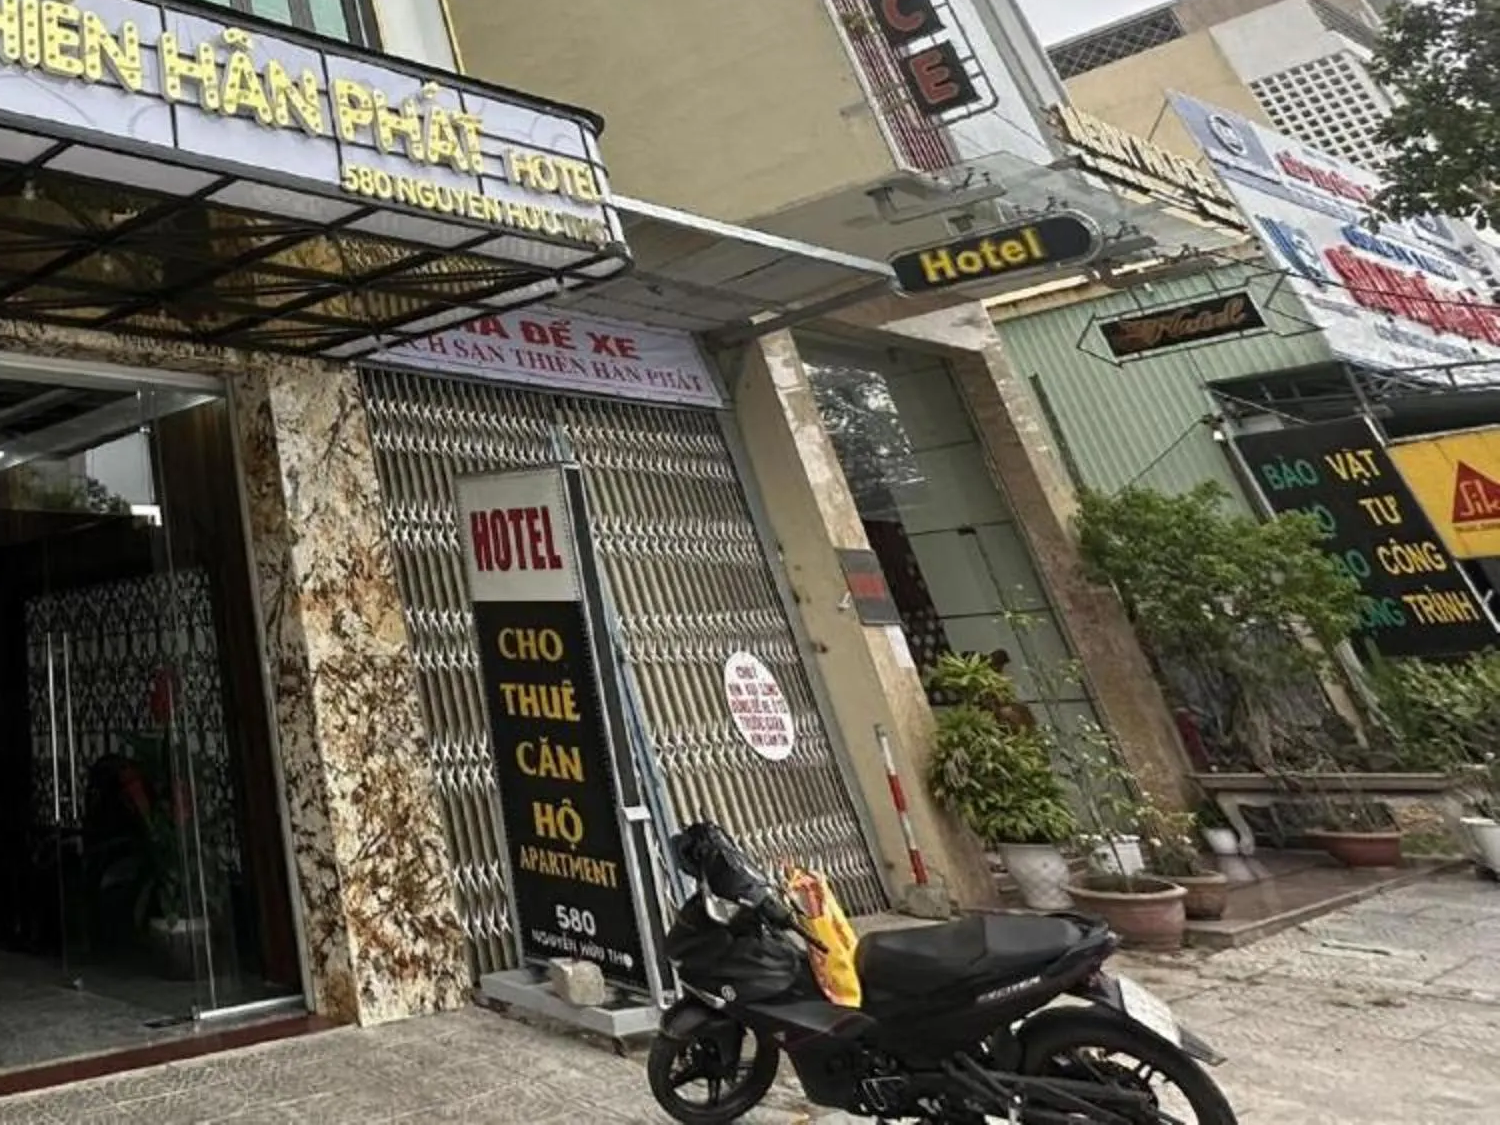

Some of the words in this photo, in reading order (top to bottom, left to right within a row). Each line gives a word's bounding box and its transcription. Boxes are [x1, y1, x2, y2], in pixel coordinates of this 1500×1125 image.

[157, 27, 325, 136] HÂN
[331, 78, 484, 175] PHÁT
[506, 148, 603, 204] HOTEL
[340, 161, 394, 200] 580
[919, 228, 1046, 284] Hotel
[586, 332, 642, 361] XE
[1324, 448, 1382, 487] VẬT
[469, 504, 564, 572] HOTEL
[1376, 537, 1448, 576] CÔNG
[1402, 584, 1481, 627] TRÌNH
[497, 627, 565, 662] CHO
[500, 679, 582, 723] THUÊ
[515, 735, 586, 783] CĂN
[531, 797, 584, 852] HỘ
[519, 843, 618, 889] APARTMENT
[555, 903, 597, 937] 580
